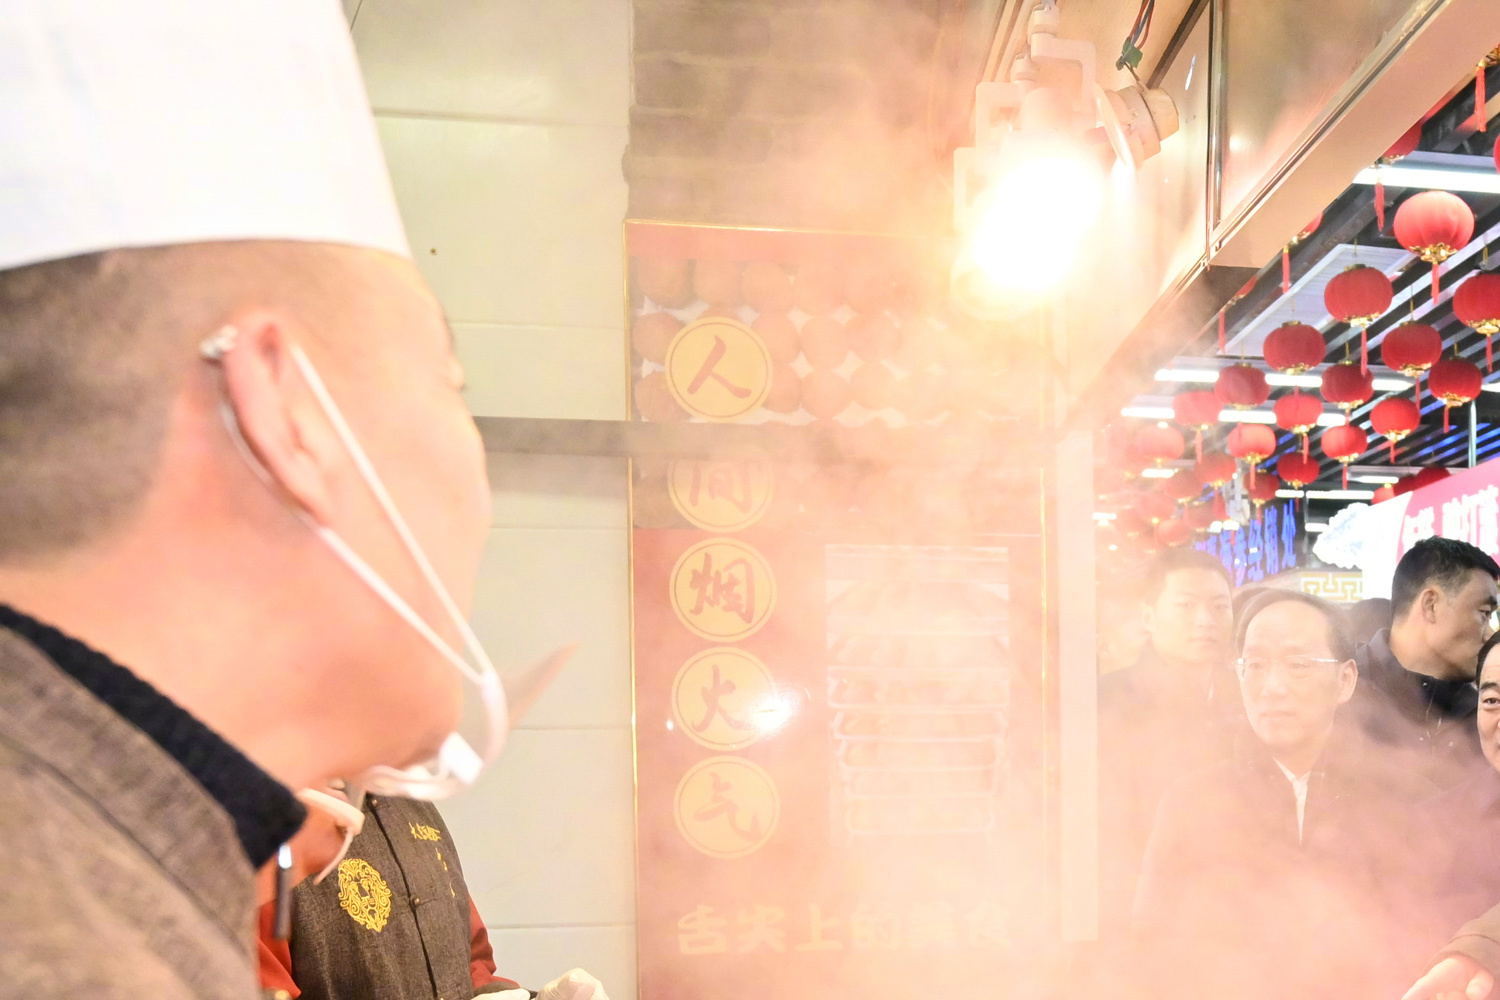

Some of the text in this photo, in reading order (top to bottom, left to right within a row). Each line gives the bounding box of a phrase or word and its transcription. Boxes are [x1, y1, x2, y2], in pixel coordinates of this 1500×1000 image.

[687, 335, 761, 842] 人间烟火气
[676, 901, 1013, 956] 舌尖上的美食
